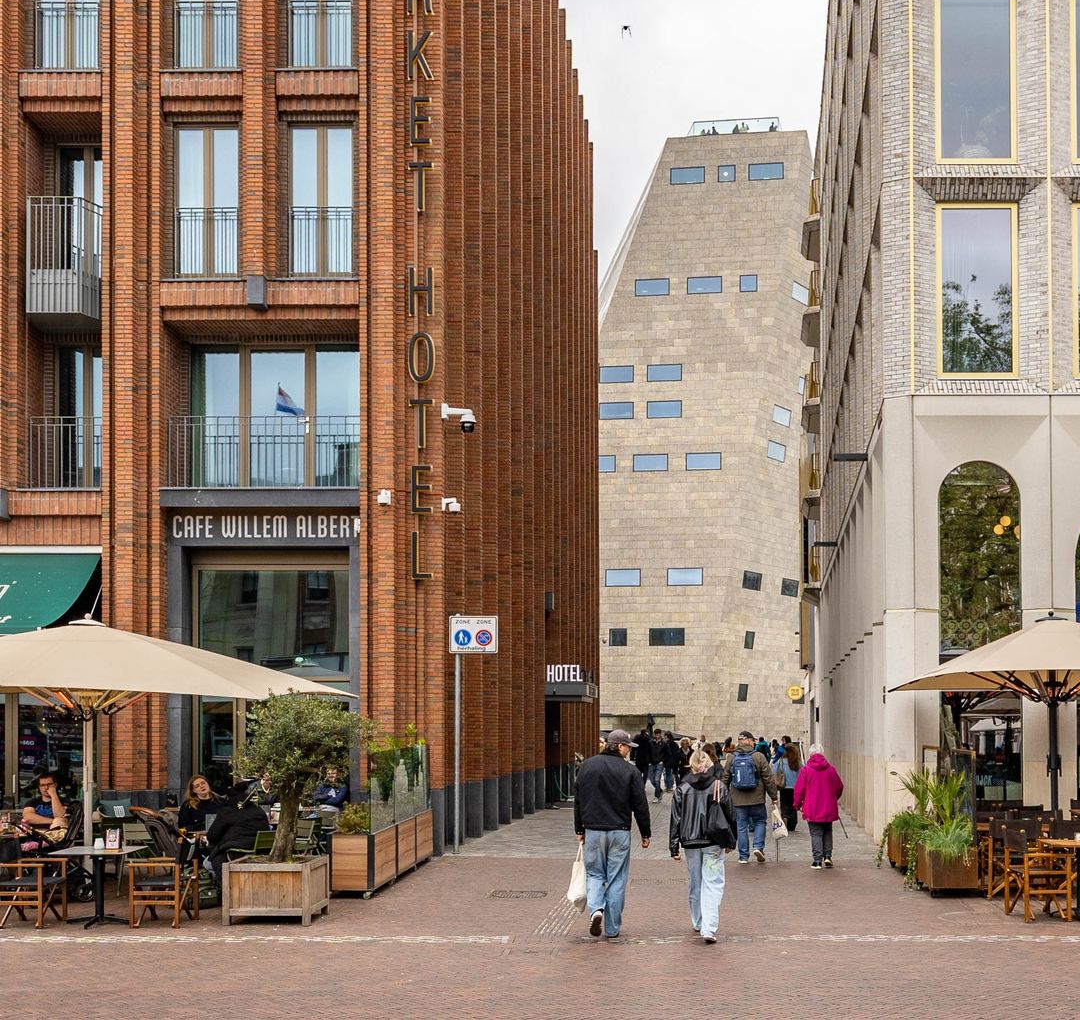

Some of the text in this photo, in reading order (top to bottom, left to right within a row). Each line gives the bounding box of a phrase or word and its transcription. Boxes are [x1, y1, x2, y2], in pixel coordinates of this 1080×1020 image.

[407, 266, 435, 580] HOTEL
[172, 515, 214, 539] CAFE
[221, 515, 288, 539] WILLEM
[546, 664, 583, 682] HOTEL
